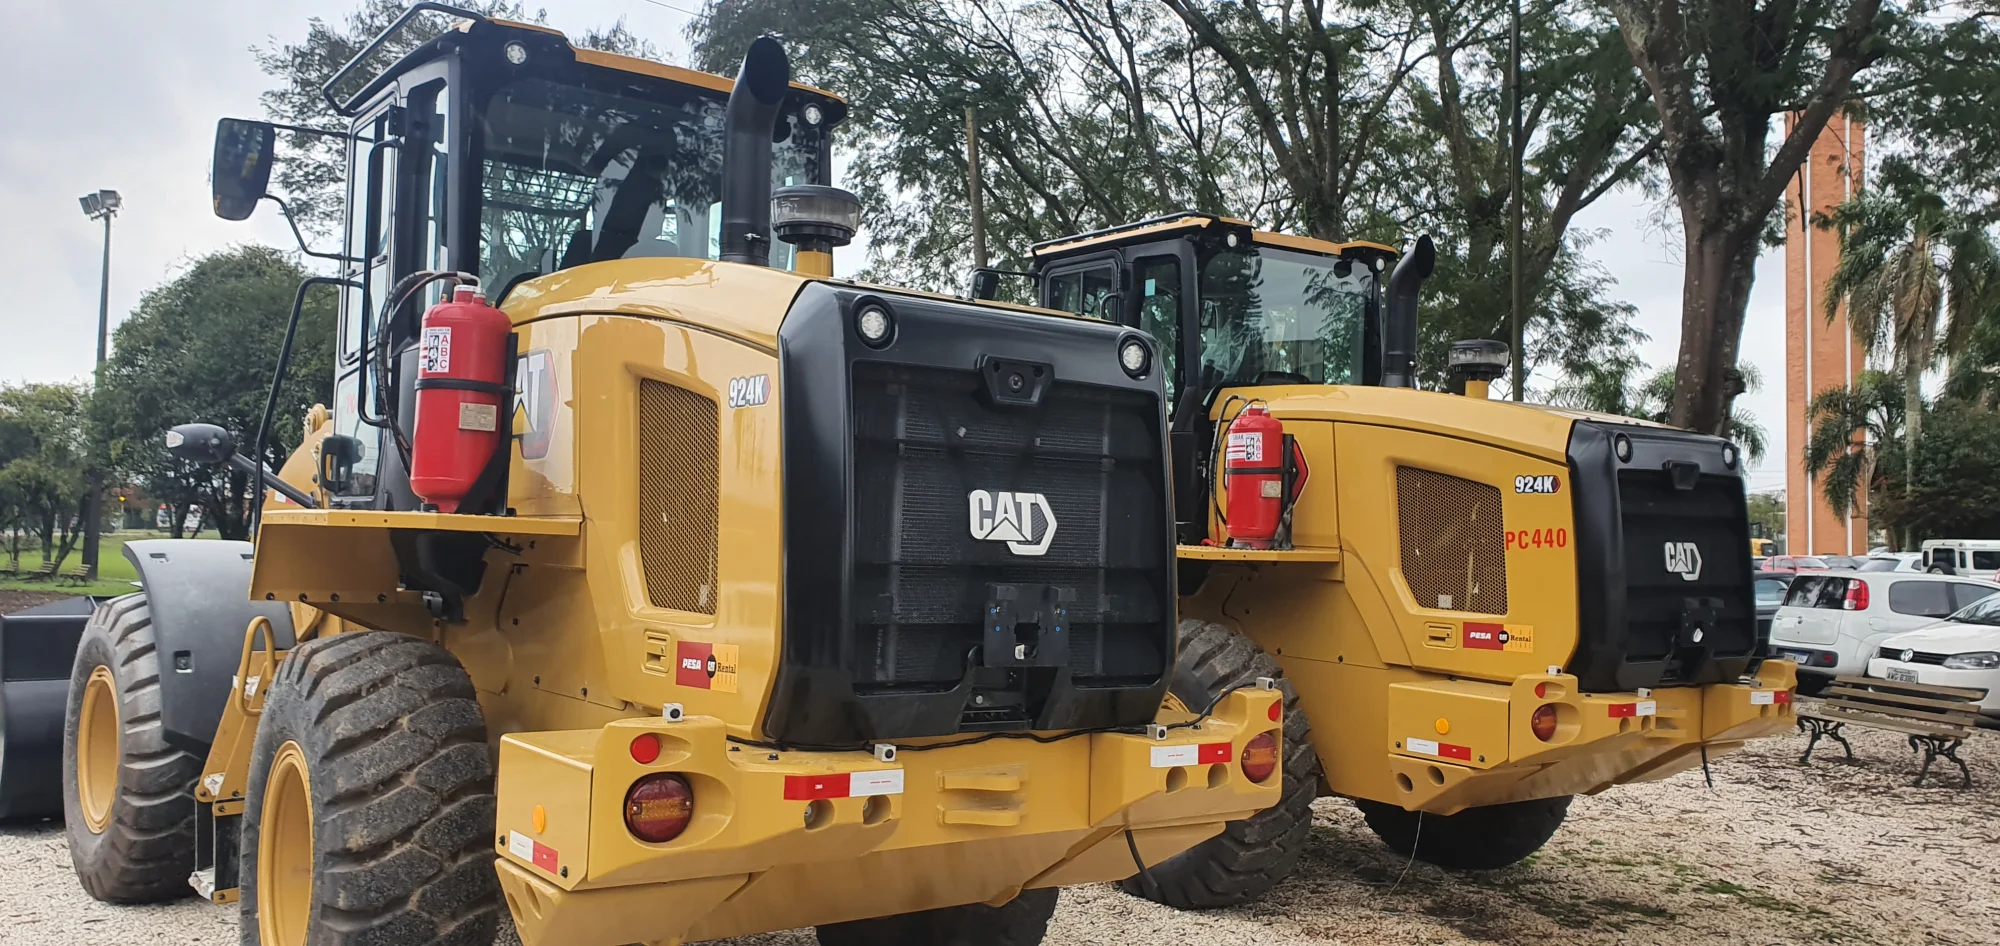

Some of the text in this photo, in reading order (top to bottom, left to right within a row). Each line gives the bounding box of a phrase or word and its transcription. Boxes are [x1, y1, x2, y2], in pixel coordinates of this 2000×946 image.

[441, 335, 449, 345] A
[440, 347, 448, 357] B
[440, 359, 448, 369] C
[729, 375, 766, 408] 924K
[1515, 475, 1555, 493] 924K
[969, 489, 1040, 543] CAT
[1505, 528, 1567, 551] PC440
[1664, 541, 1696, 573] CAT
[1469, 631, 1492, 640] PESA
[682, 658, 702, 671] PESA
[717, 662, 737, 674] Rental
